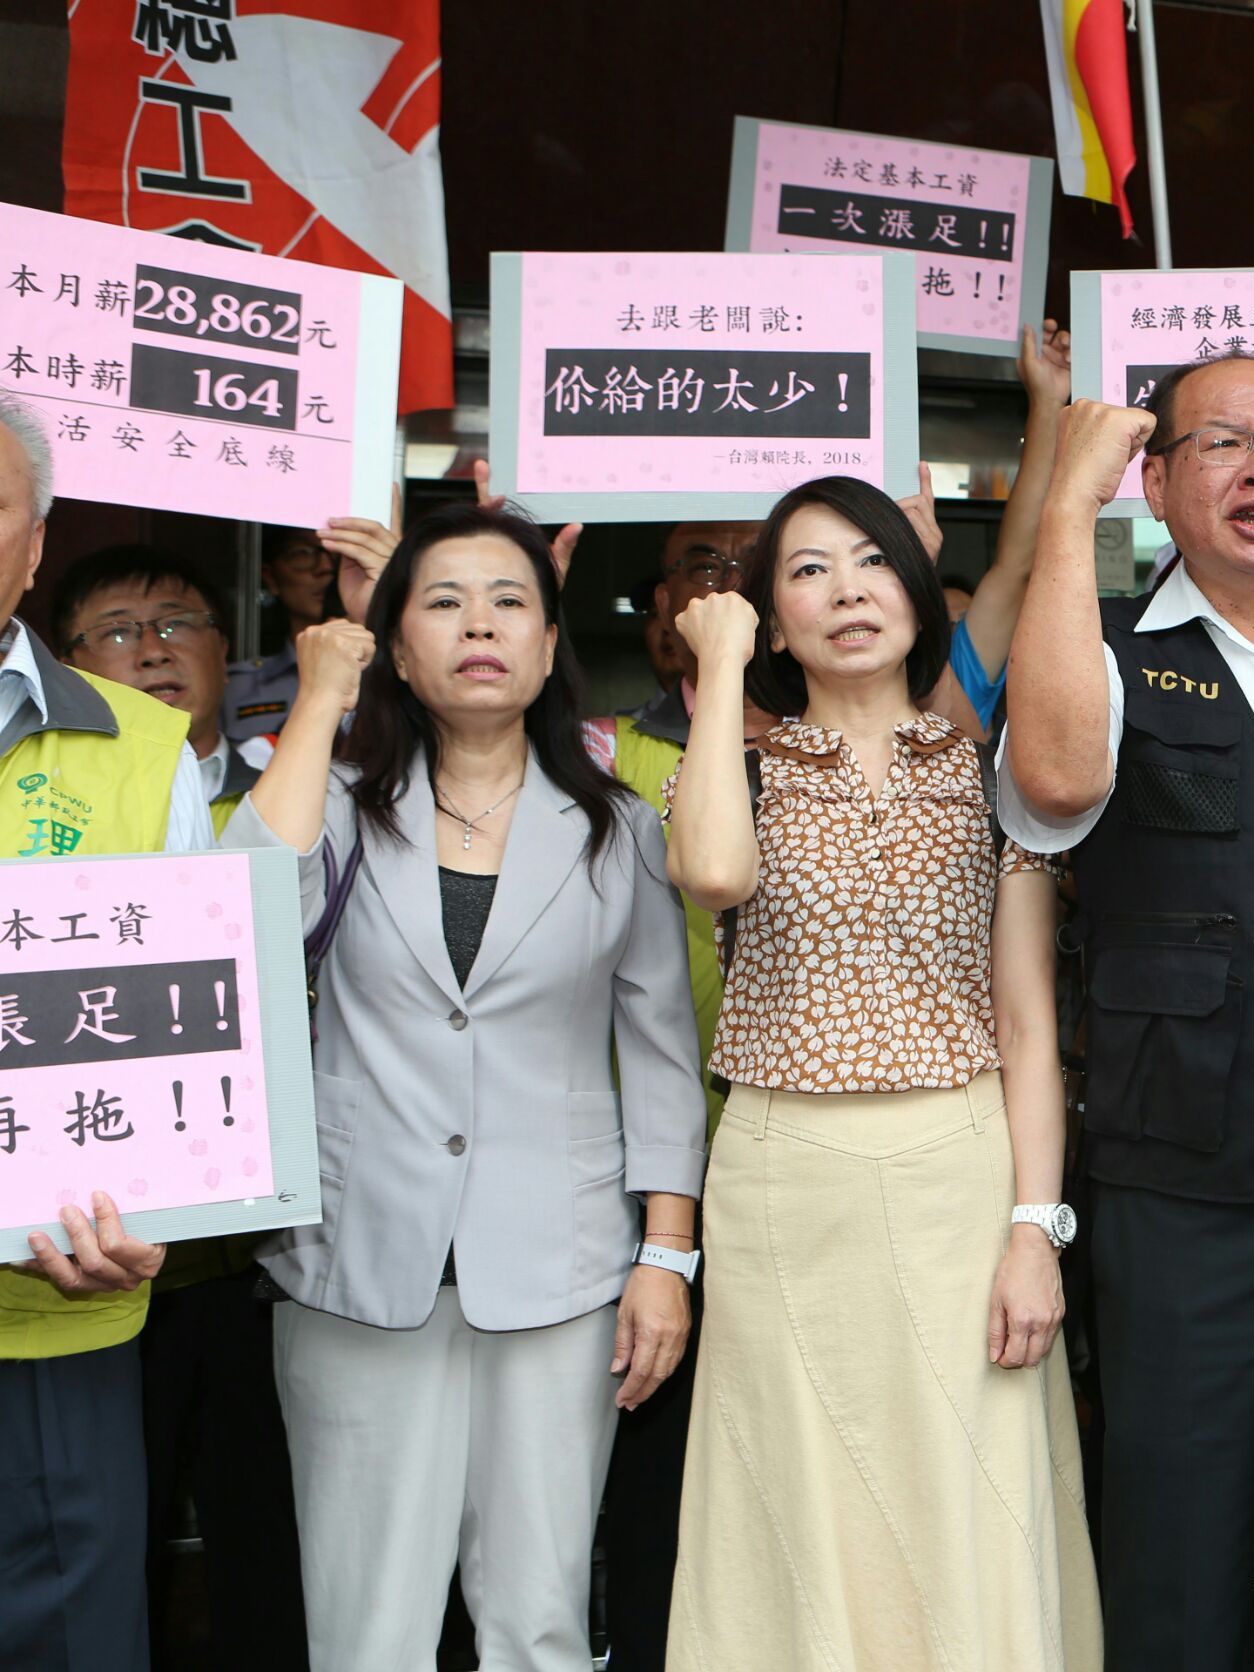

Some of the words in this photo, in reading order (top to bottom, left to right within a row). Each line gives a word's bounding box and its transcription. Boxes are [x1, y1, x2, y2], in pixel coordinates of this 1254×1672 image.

[823, 156, 980, 197] 法定基本工資
[782, 201, 1011, 252] 一次漲足!!
[616, 303, 803, 334] 去跟老闆說:
[545, 365, 849, 414] 你給的太少!
[57, 412, 299, 474] 活安全底線
[1141, 667, 1219, 700] TCTU
[0, 902, 153, 951] 本工資
